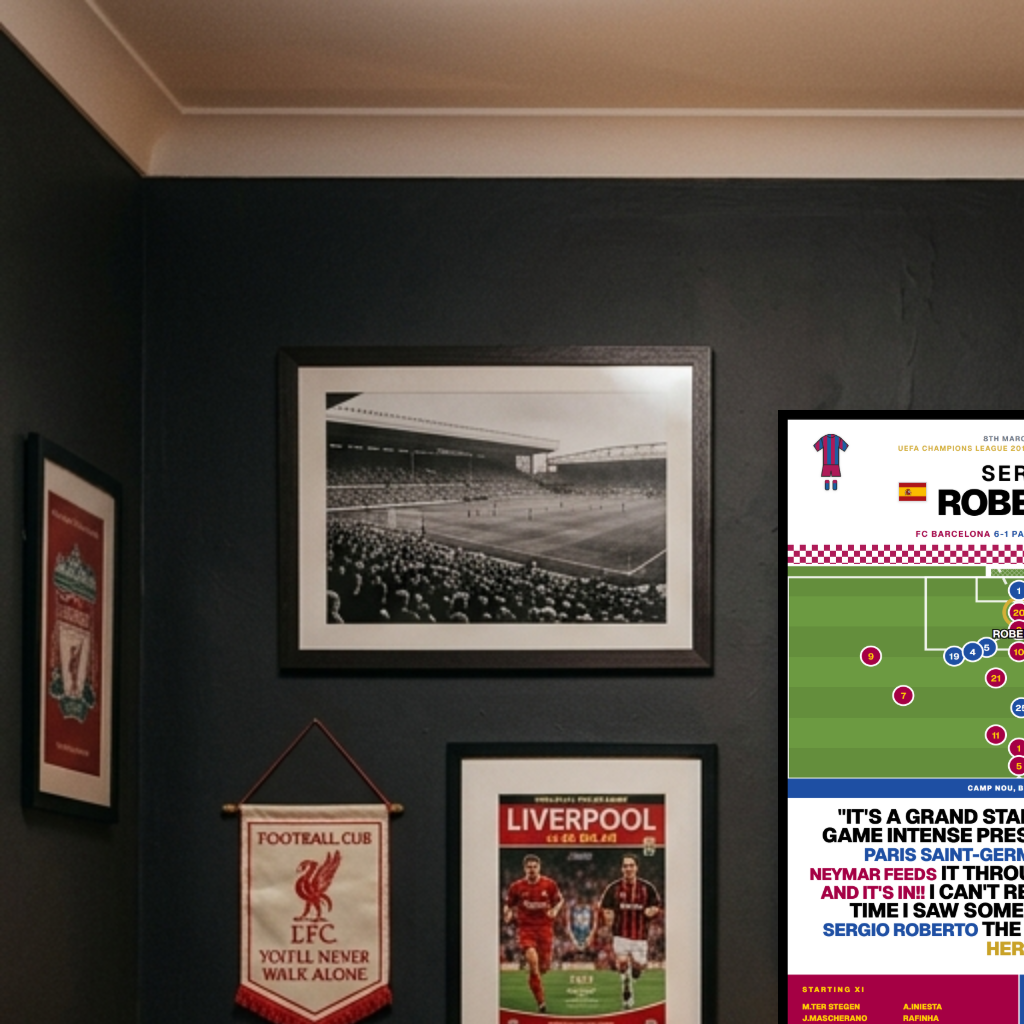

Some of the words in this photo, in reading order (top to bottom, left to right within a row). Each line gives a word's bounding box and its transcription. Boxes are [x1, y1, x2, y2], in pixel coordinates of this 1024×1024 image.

[982, 435, 1000, 443] 8TH
[897, 444, 920, 452] UEFA
[921, 444, 973, 452] CHAMPIONS
[975, 444, 1008, 452] LEAGUE
[915, 529, 929, 538] FC
[931, 529, 991, 538] BARCELONA
[993, 530, 1009, 538] 6-1
[967, 784, 993, 792] CAMP
[994, 784, 1016, 793] NOU,
[507, 807, 656, 831] LIVERPOOL
[838, 808, 882, 824] "IT'S
[886, 809, 902, 824] A
[905, 808, 978, 824] GRAND
[822, 827, 883, 843] GAME
[887, 827, 972, 843] INTENSE
[865, 848, 916, 862] PARIS
[810, 868, 880, 880] NEYMAR
[884, 868, 937, 881] FEEDS
[942, 865, 960, 880] IT
[821, 886, 859, 899] AND
[863, 885, 894, 900] IT'S
[898, 886, 925, 899] IN!!
[930, 884, 934, 899] I
[939, 884, 1000, 900] CAN'T
[849, 903, 899, 918] TIME
[903, 903, 908, 918] I
[913, 902, 959, 918] SAW
[823, 923, 890, 937] SERGIO
[894, 923, 978, 937] ROBERTO
[982, 921, 1021, 936] THE
[318, 949, 370, 964] NEVER
[311, 967, 368, 981] ALONE
[801, 985, 851, 993] STARTING
[801, 1003, 827, 1011] M.TER
[827, 1002, 861, 1011] STEGEN
[902, 1002, 943, 1011] A.INIESTA
[801, 1014, 868, 1022] J.MASCHERANO
[902, 1014, 940, 1022] RAFINHA
